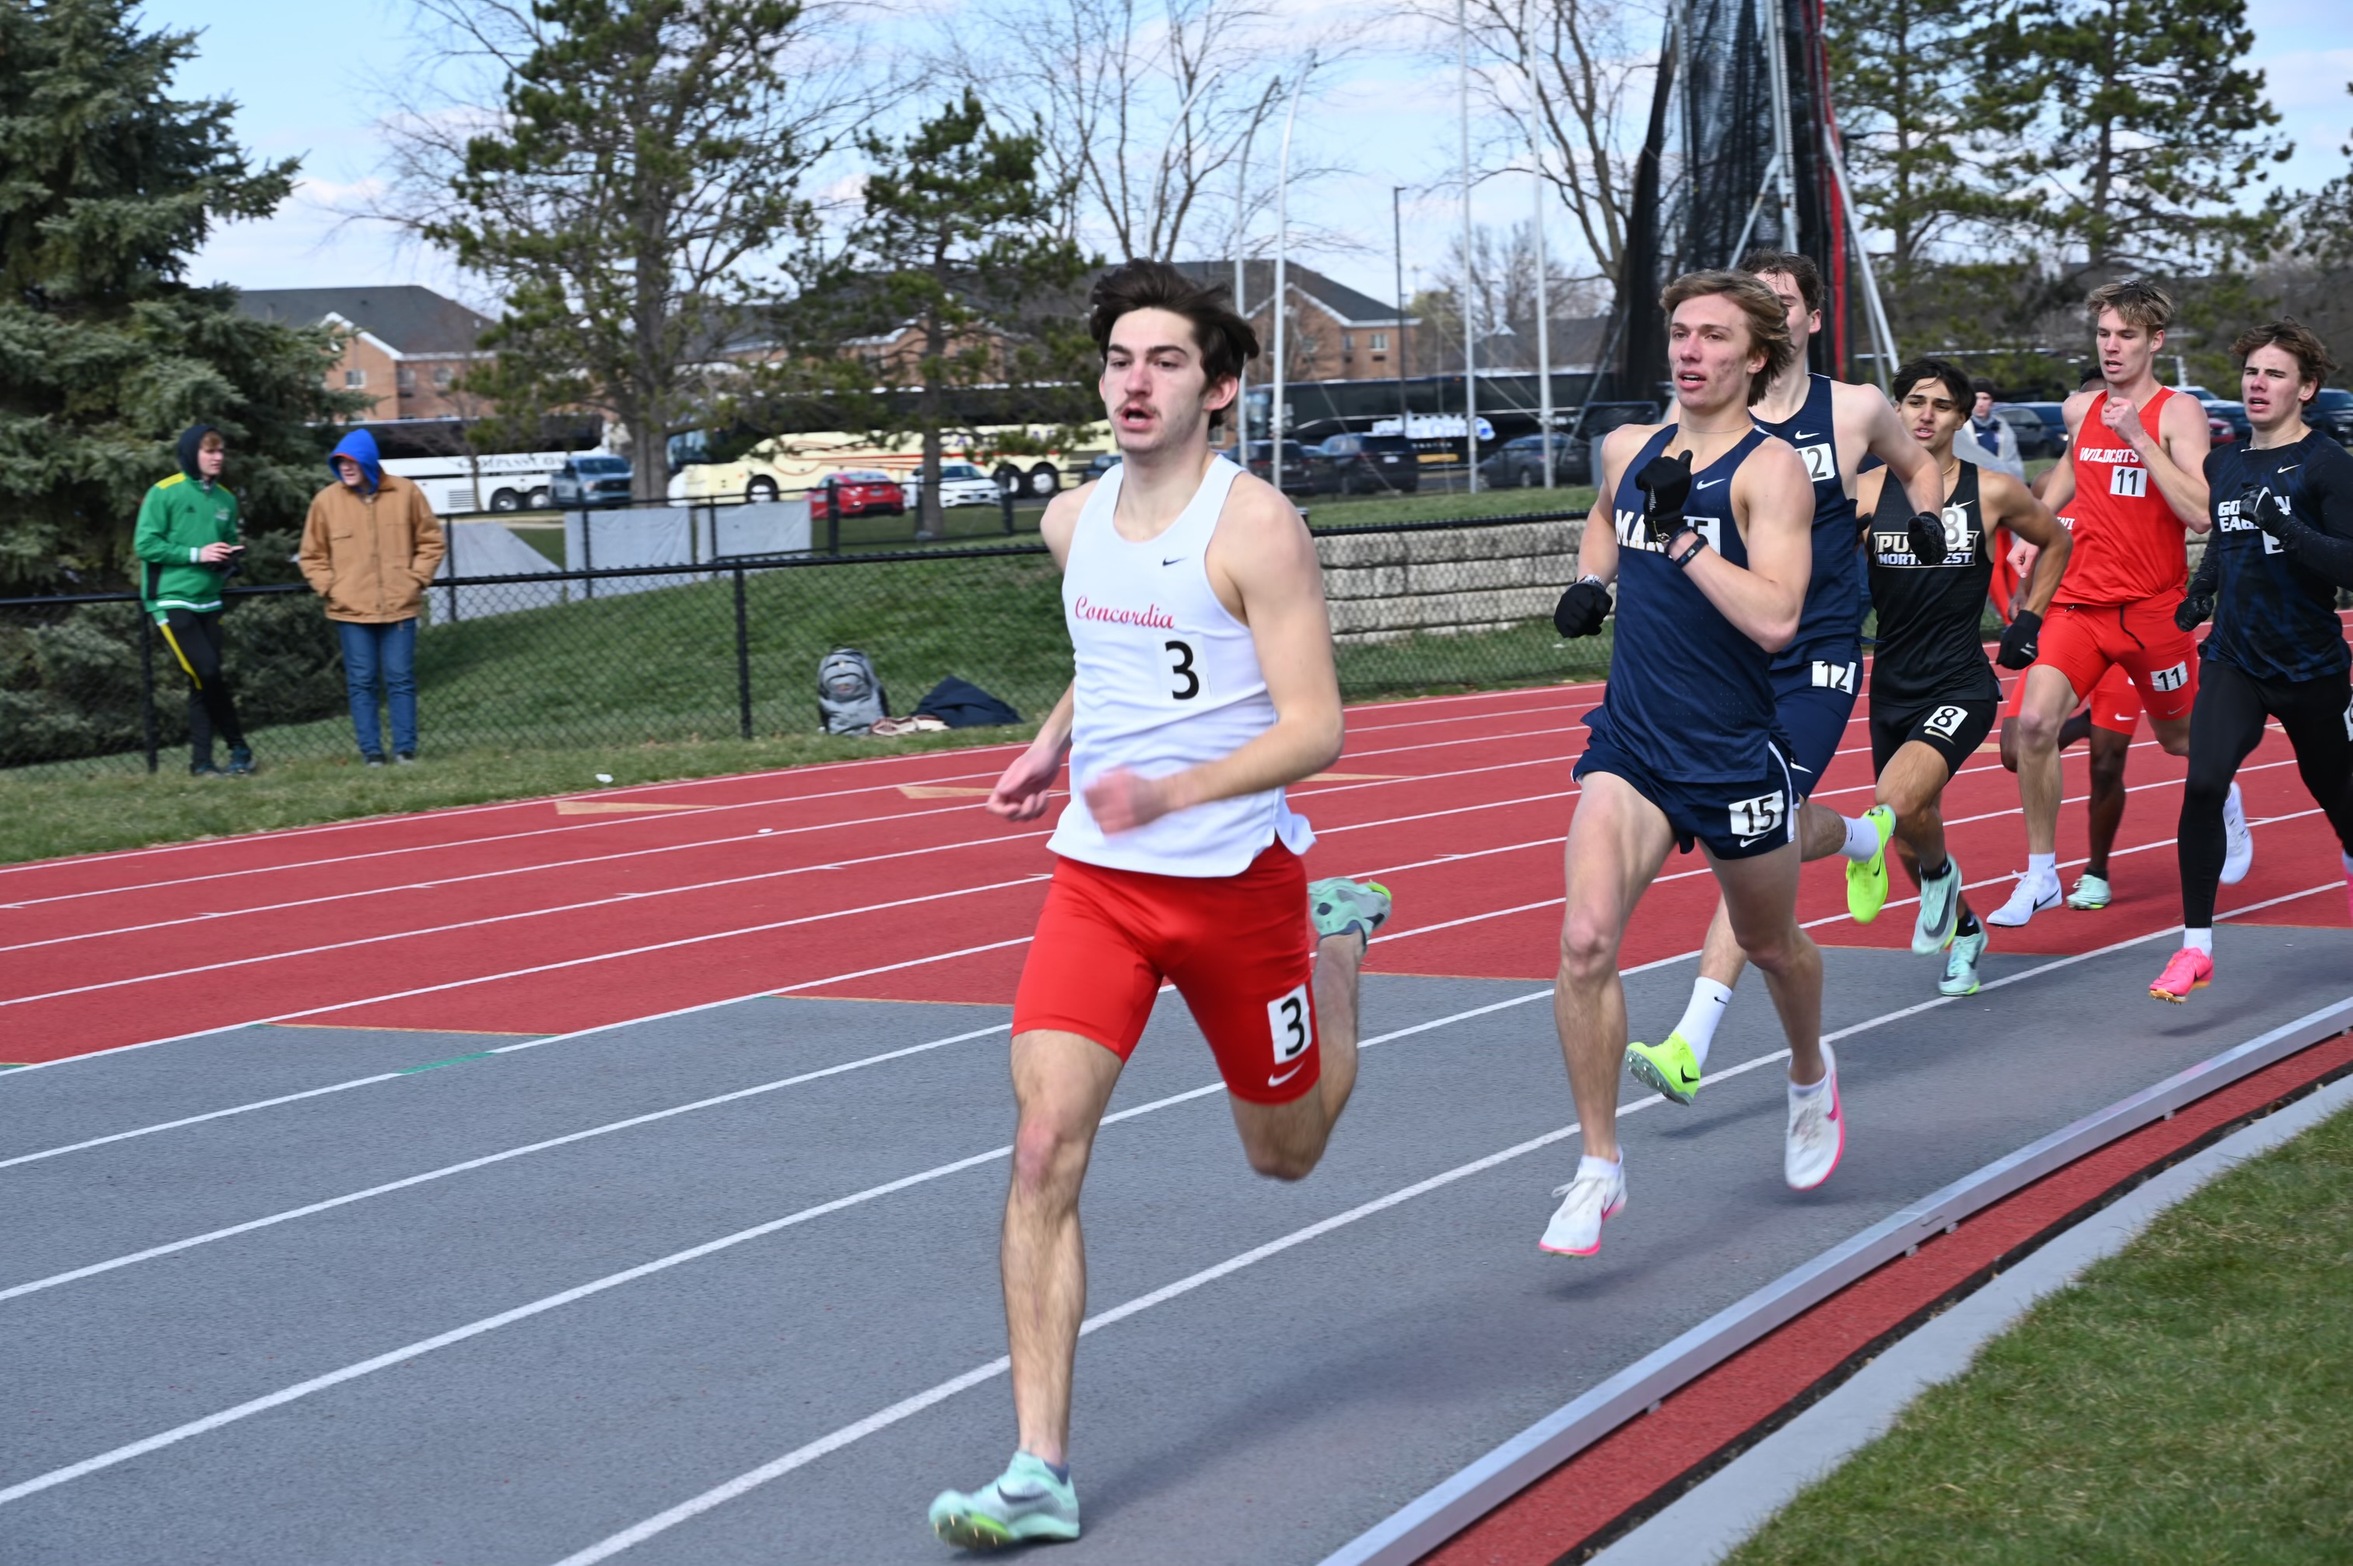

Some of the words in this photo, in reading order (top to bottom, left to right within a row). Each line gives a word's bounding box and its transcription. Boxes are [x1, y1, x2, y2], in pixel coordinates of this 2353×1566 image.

[1797, 447, 1827, 479] 2
[2080, 447, 2139, 463] WILDCATS
[2117, 468, 2138, 495] 11
[1878, 552, 1973, 566] NORTEST
[1075, 595, 1174, 629] Concordia
[1164, 640, 1200, 700] 3
[1821, 662, 1847, 690] 12
[2157, 667, 2182, 691] 11
[1933, 707, 1959, 728] 8
[1741, 796, 1776, 834] 15
[1281, 996, 1305, 1056] 3
